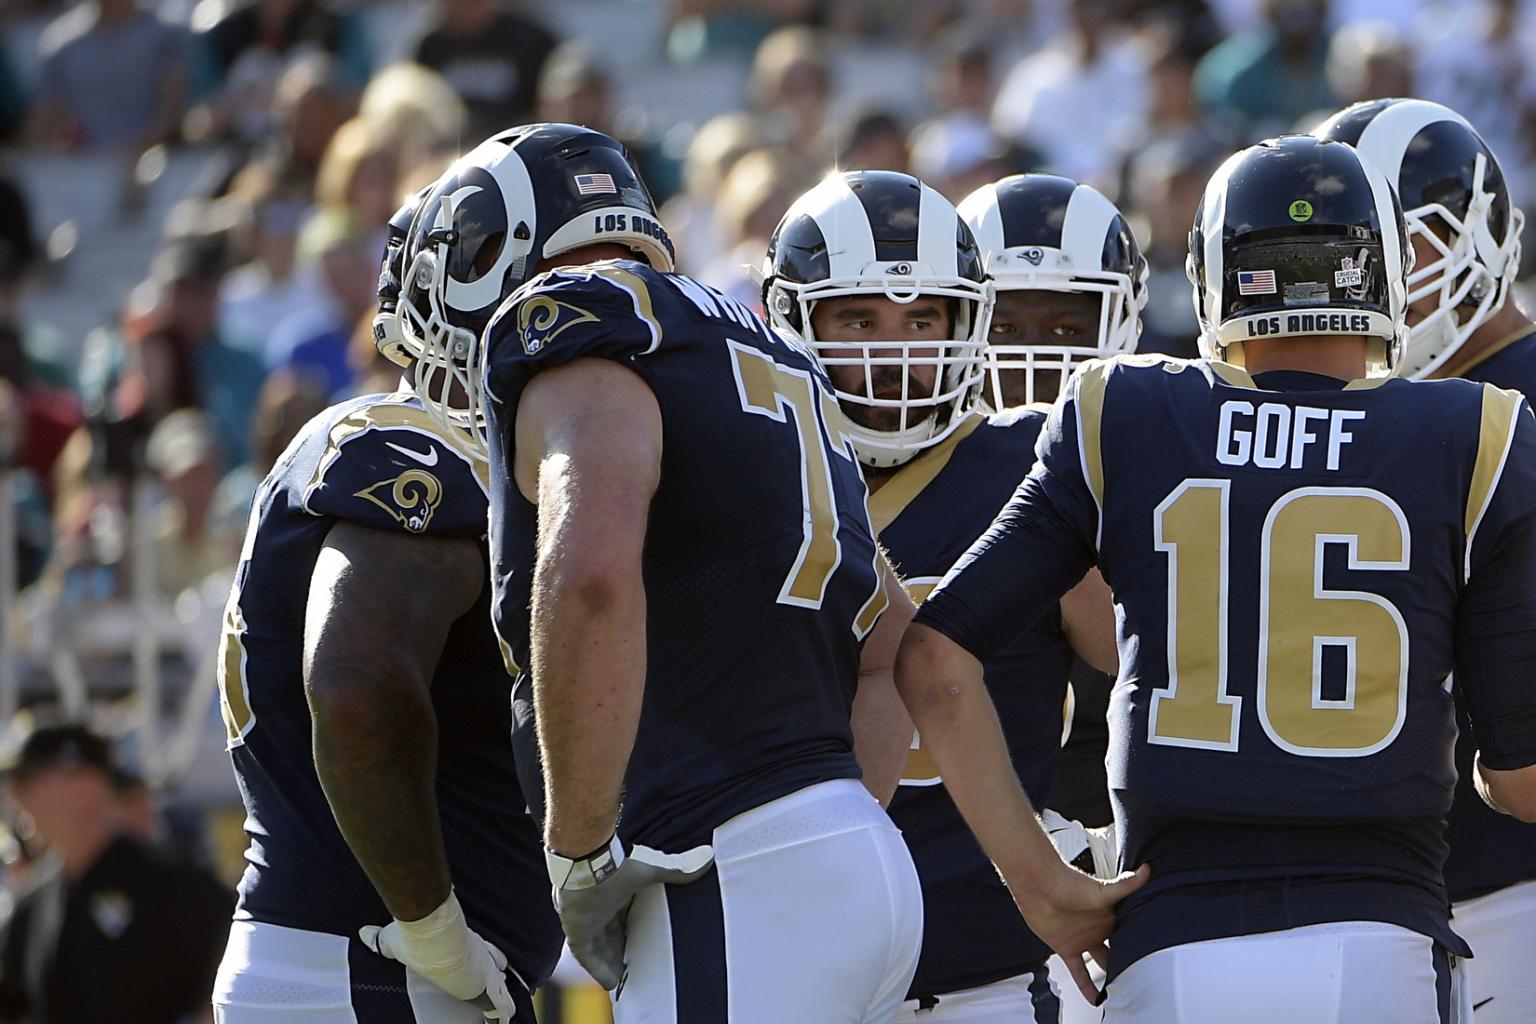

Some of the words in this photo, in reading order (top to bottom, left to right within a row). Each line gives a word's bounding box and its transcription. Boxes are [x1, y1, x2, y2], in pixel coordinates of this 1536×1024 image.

[594, 214, 627, 234] LOS
[1336, 276, 1361, 285] CATCH
[1247, 317, 1280, 337] LOS
[1287, 313, 1371, 333] ANGELES
[1215, 400, 1366, 471] GOFF
[726, 337, 889, 642] 77
[1147, 478, 1411, 758] 16
